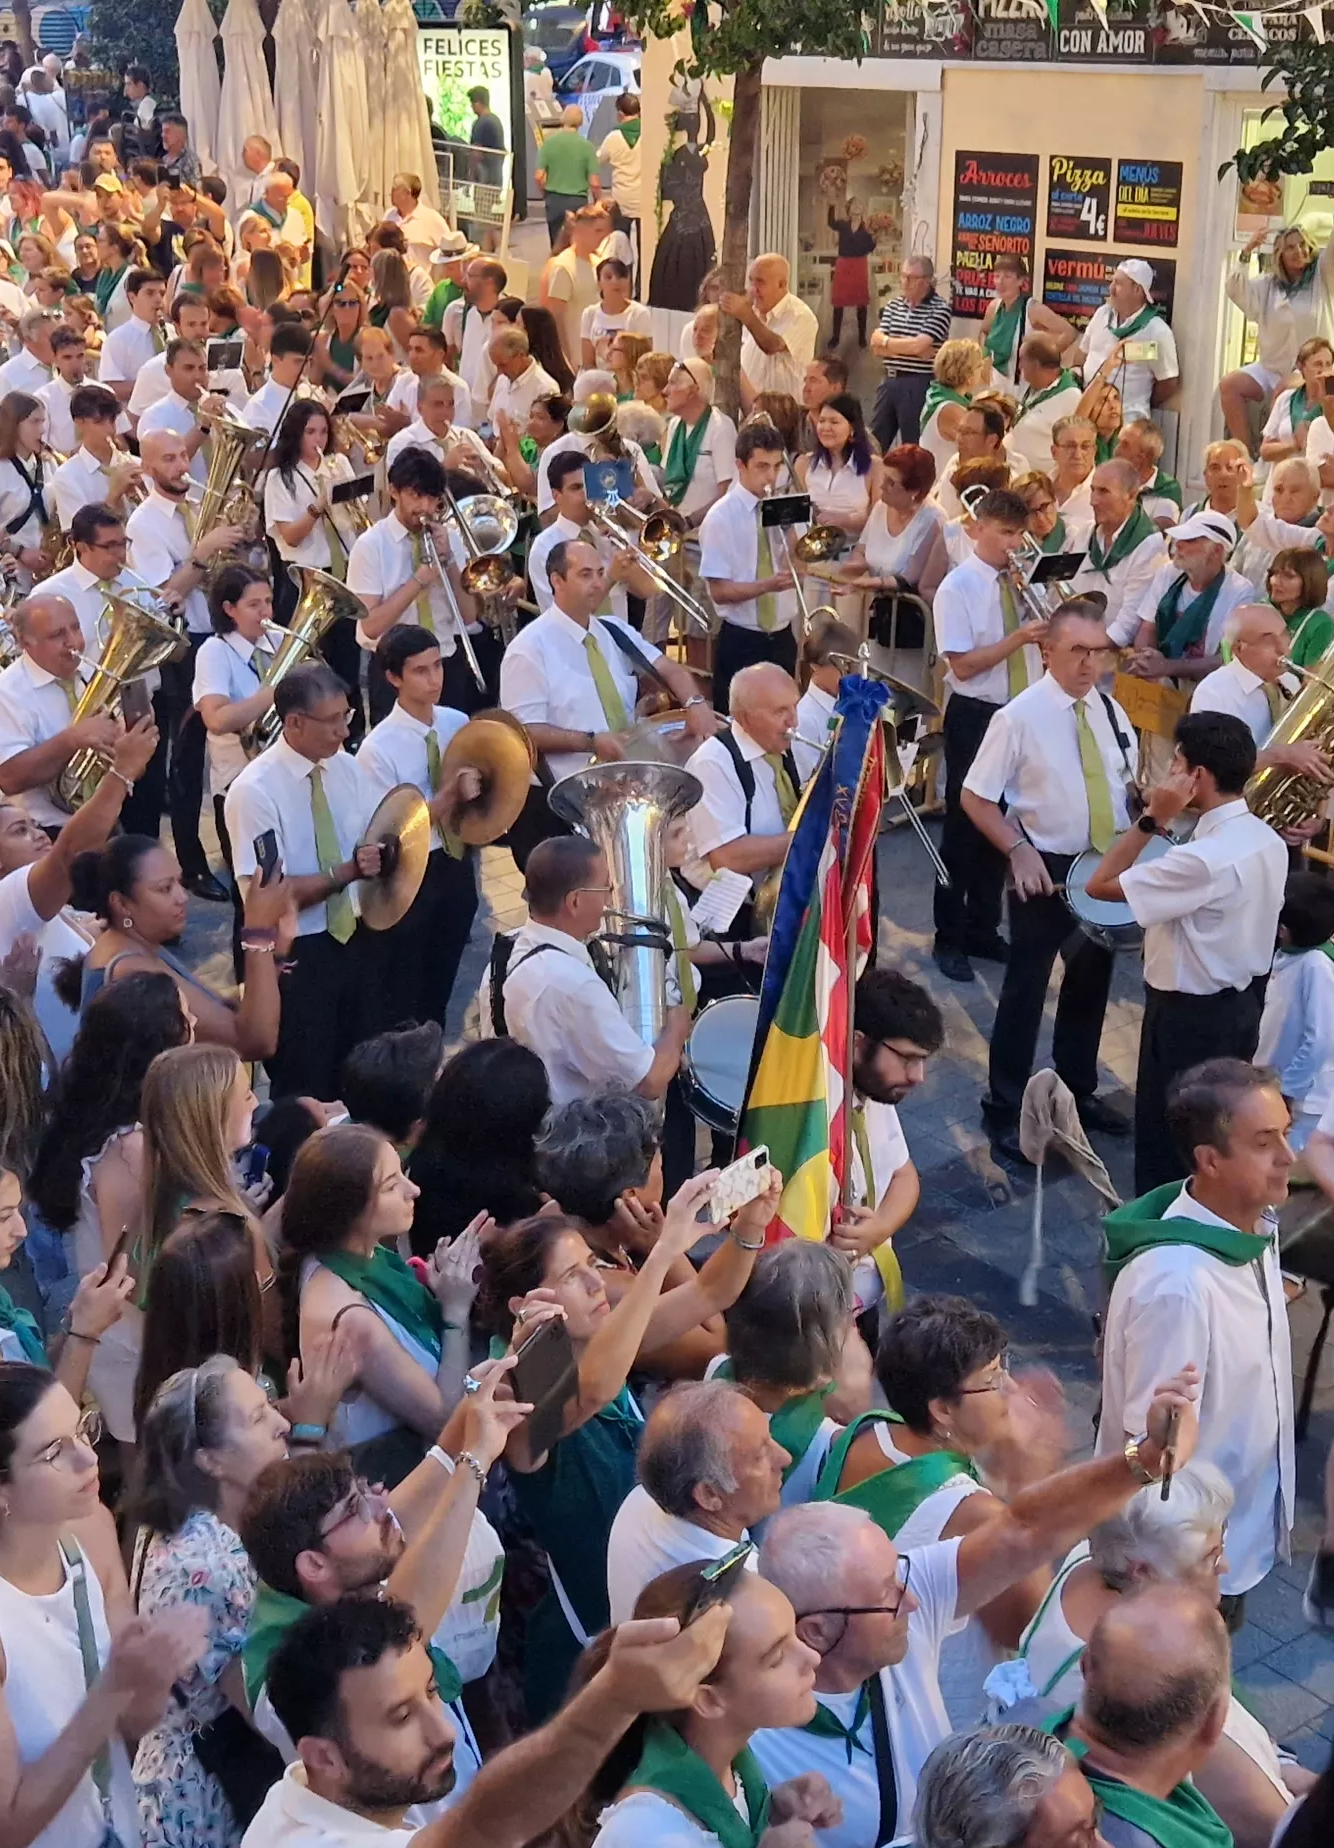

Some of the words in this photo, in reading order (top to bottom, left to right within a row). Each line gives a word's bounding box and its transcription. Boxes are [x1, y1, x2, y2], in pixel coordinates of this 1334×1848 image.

[983, 23, 1038, 40] masa
[1060, 29, 1092, 53] CON
[1096, 30, 1145, 54] AMOR
[423, 38, 502, 56] FELICES
[976, 40, 1048, 59] casera
[423, 60, 502, 78] FIESTAS
[959, 160, 1034, 188] Arroces
[1051, 156, 1107, 192] Pizza
[1119, 162, 1159, 183] MENÚS
[1118, 185, 1133, 202] DEL
[958, 212, 993, 231] ARROZ
[996, 215, 1031, 233] NEGRO
[1047, 256, 1105, 280] vermú
